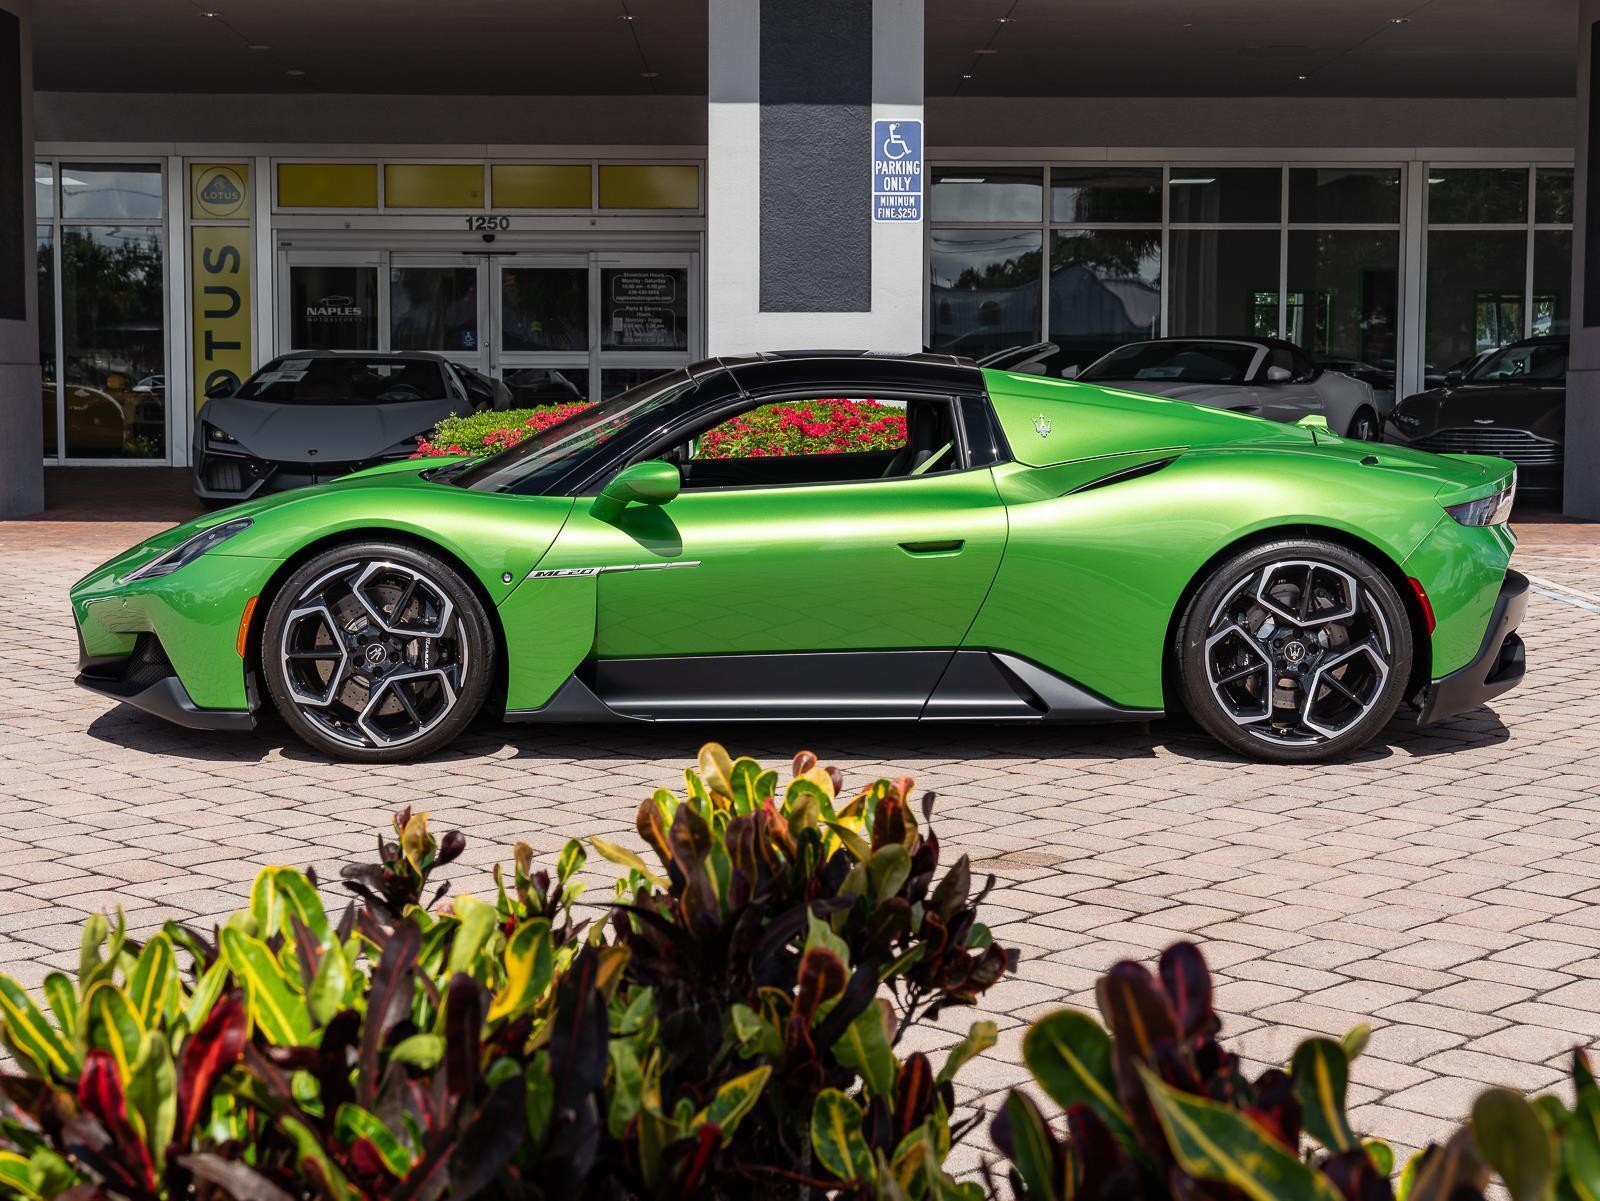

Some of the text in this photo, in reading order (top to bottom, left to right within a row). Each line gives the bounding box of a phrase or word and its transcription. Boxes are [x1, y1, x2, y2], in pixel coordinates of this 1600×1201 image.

[875, 160, 920, 175] PARKING
[883, 176, 911, 191] ONLY
[203, 192, 239, 200] LOTUS
[880, 195, 915, 206] MINIMUM
[877, 207, 917, 219] FINE $250
[465, 216, 510, 231] 1250
[306, 307, 362, 316] NAPLES
[203, 245, 241, 397] OTUS
[534, 568, 594, 577] MC20
